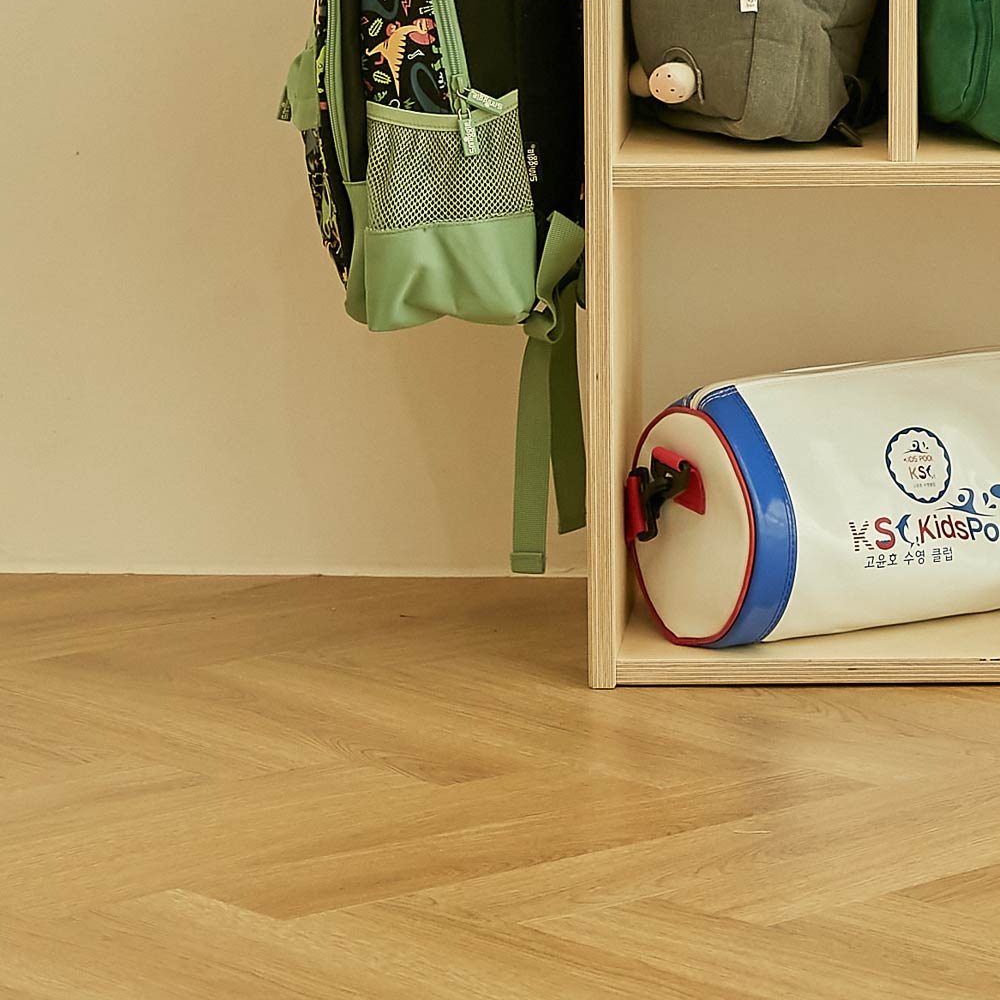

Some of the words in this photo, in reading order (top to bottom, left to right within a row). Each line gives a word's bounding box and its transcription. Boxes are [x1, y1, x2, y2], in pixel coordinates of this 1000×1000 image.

[864, 553, 898, 569] 고윤호
[904, 549, 925, 566] 수영
[931, 547, 953, 563] 클럽
